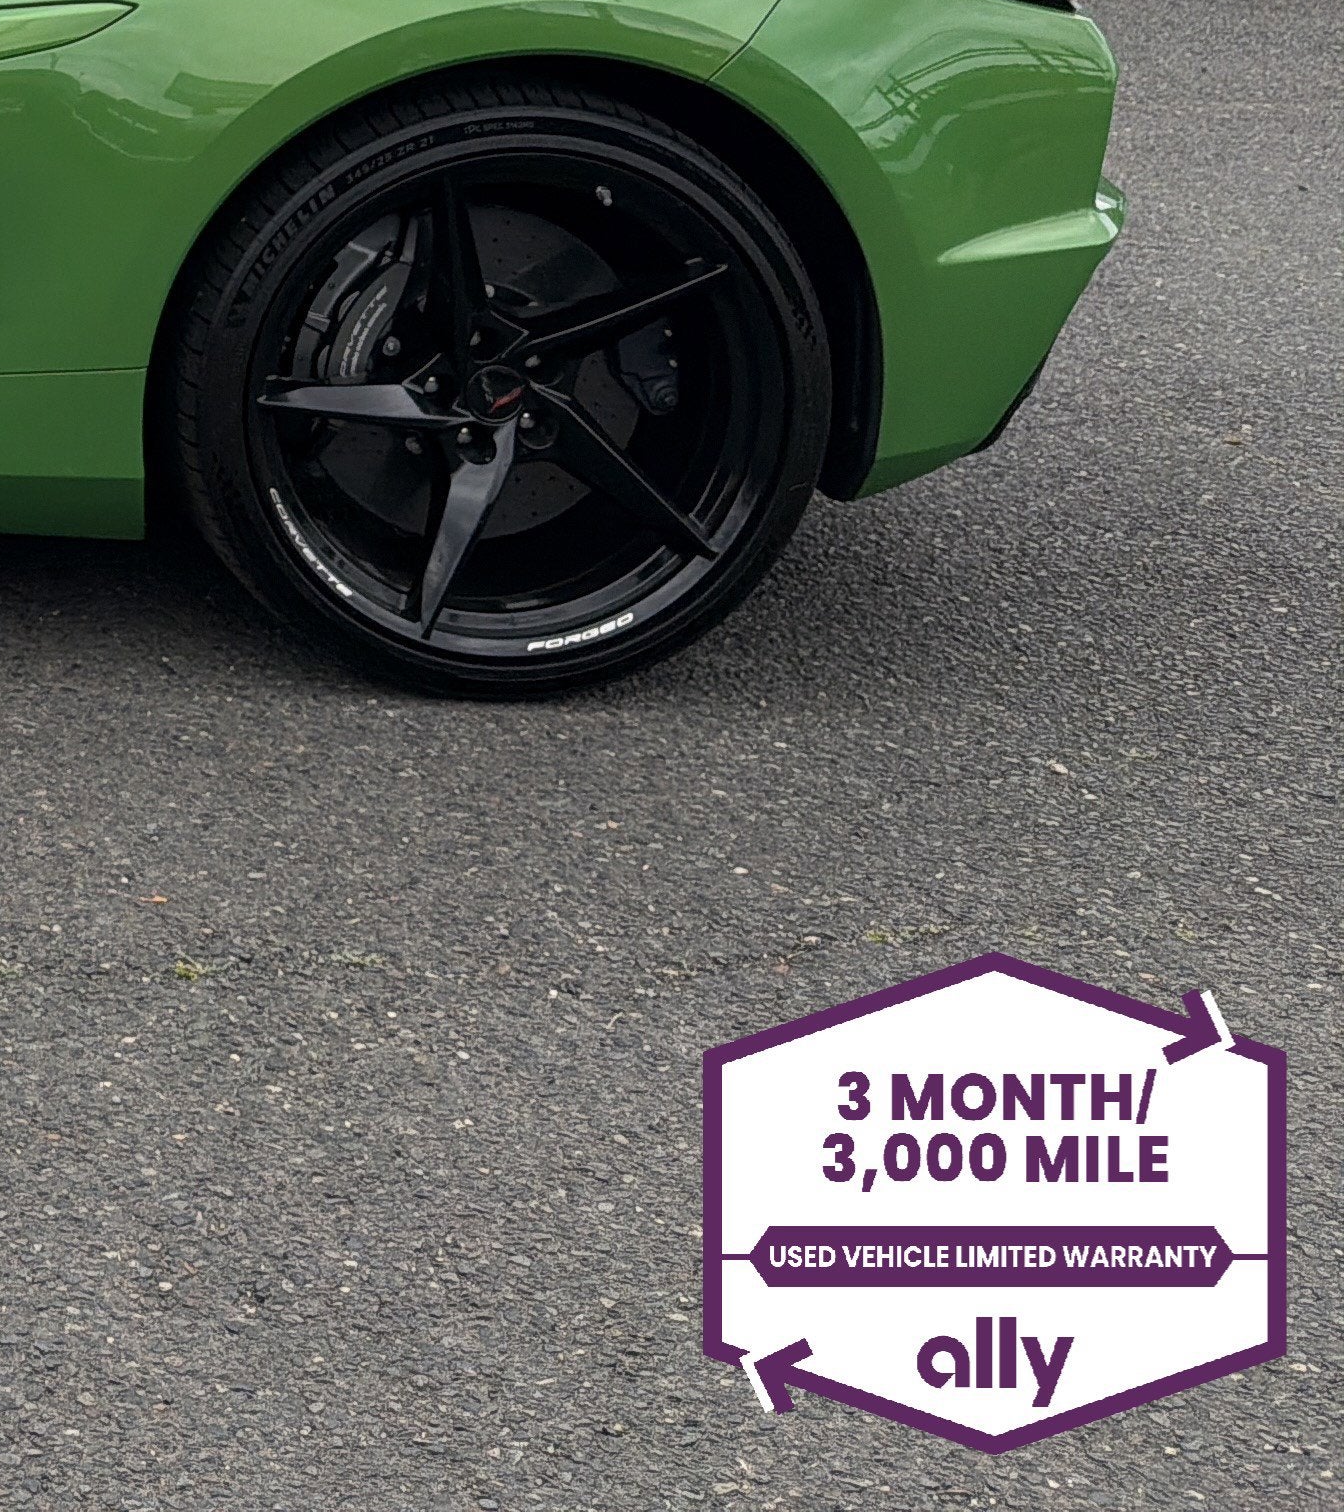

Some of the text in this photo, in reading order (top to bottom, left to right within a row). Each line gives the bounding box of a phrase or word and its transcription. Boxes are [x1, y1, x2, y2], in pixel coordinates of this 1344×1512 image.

[241, 185, 336, 297] MICHELIN
[269, 487, 353, 597] CORVETTE
[527, 612, 634, 651] FORGED
